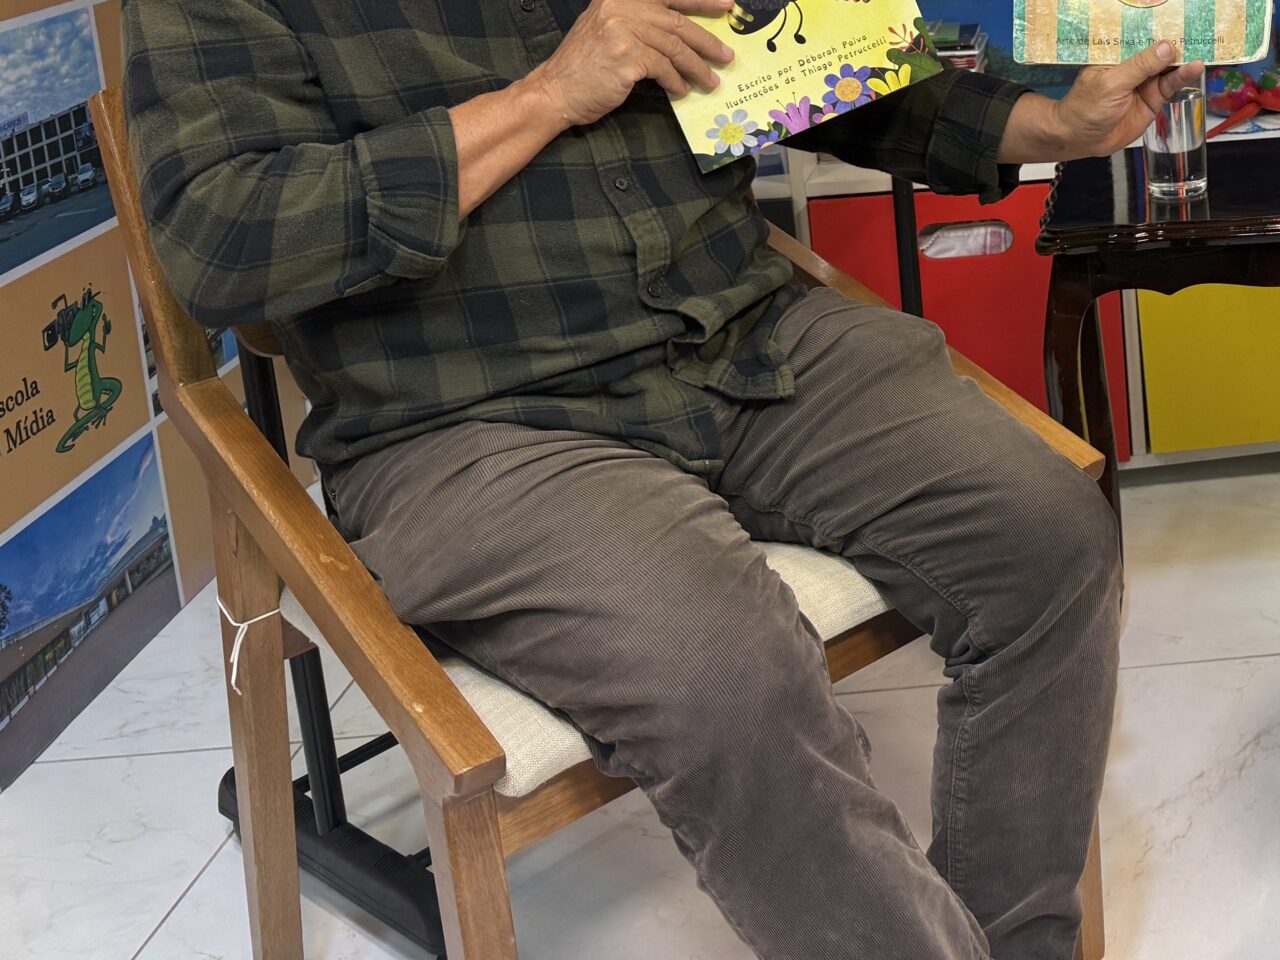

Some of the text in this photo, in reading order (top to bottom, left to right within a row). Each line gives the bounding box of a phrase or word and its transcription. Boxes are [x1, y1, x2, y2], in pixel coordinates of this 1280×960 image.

[738, 34, 868, 93] Escrito por Déborah Paiva
[784, 75, 797, 85] de
[801, 60, 834, 78] Thiago
[837, 36, 888, 63] Petruccelli
[1078, 37, 1089, 45] de
[0, 377, 40, 418] scola
[4, 407, 57, 454] Mídia
